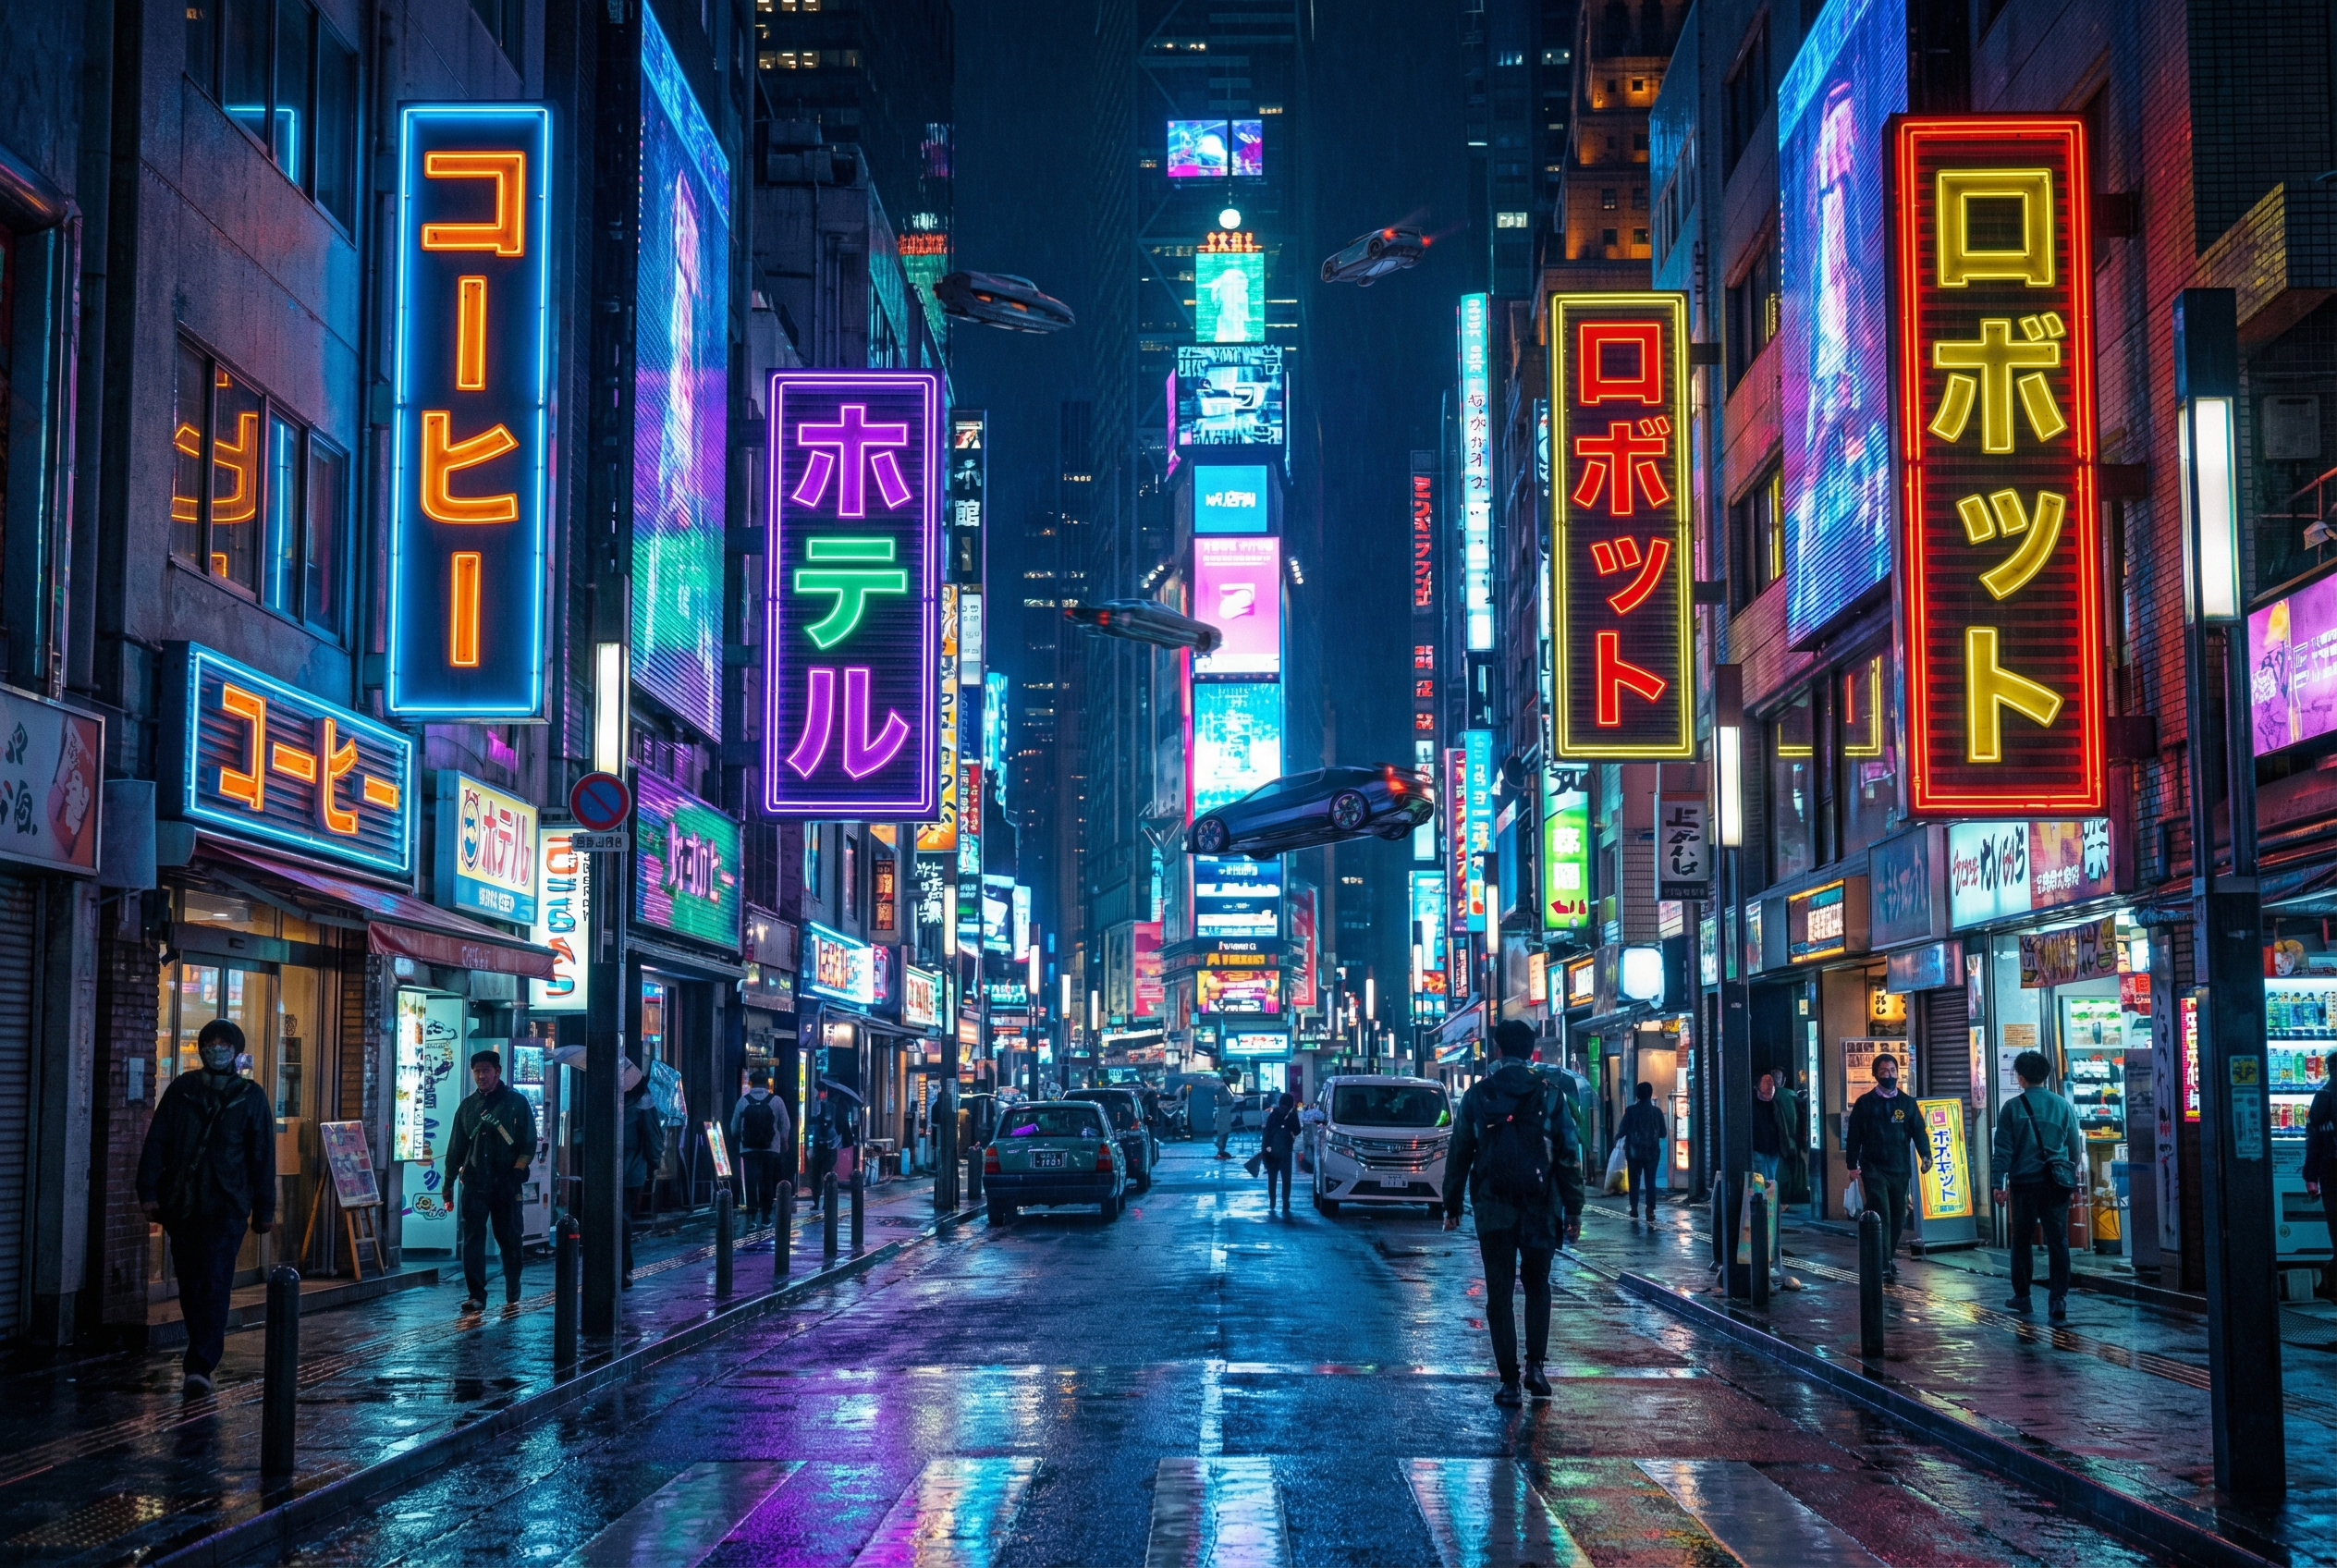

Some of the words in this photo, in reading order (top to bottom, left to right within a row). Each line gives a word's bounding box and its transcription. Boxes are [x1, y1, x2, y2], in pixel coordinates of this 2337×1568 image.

[421, 150, 526, 668] コーヒー
[786, 403, 912, 781] ホテル
[1572, 320, 1673, 728] ロボット
[1927, 167, 2069, 764] ロボット
[218, 681, 399, 835] コーヒー
[482, 800, 532, 886] ホテル
